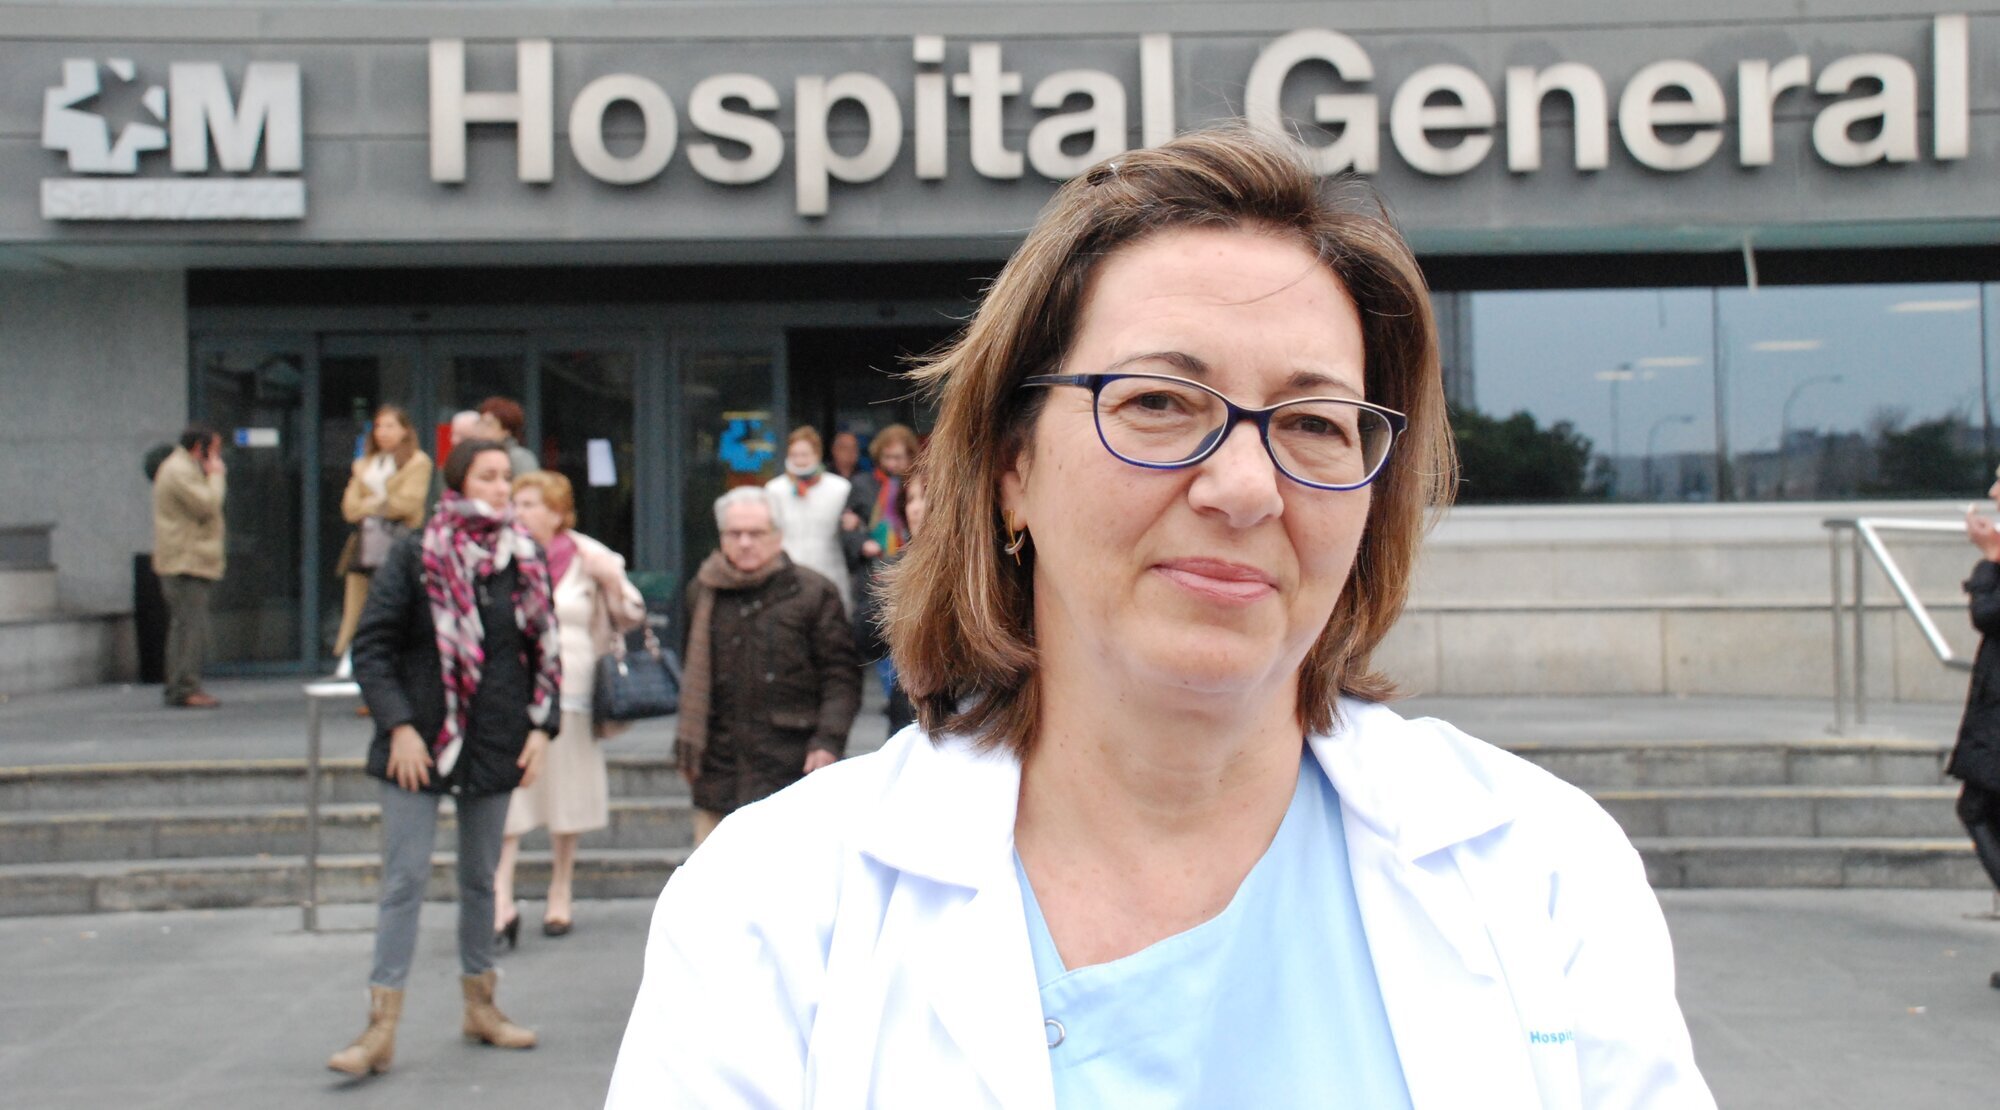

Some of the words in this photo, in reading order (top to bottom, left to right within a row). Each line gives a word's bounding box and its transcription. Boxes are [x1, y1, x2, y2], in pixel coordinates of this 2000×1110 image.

[170, 62, 303, 173] M
[430, 33, 1175, 216] Hospital
[1244, 14, 1969, 175] General
